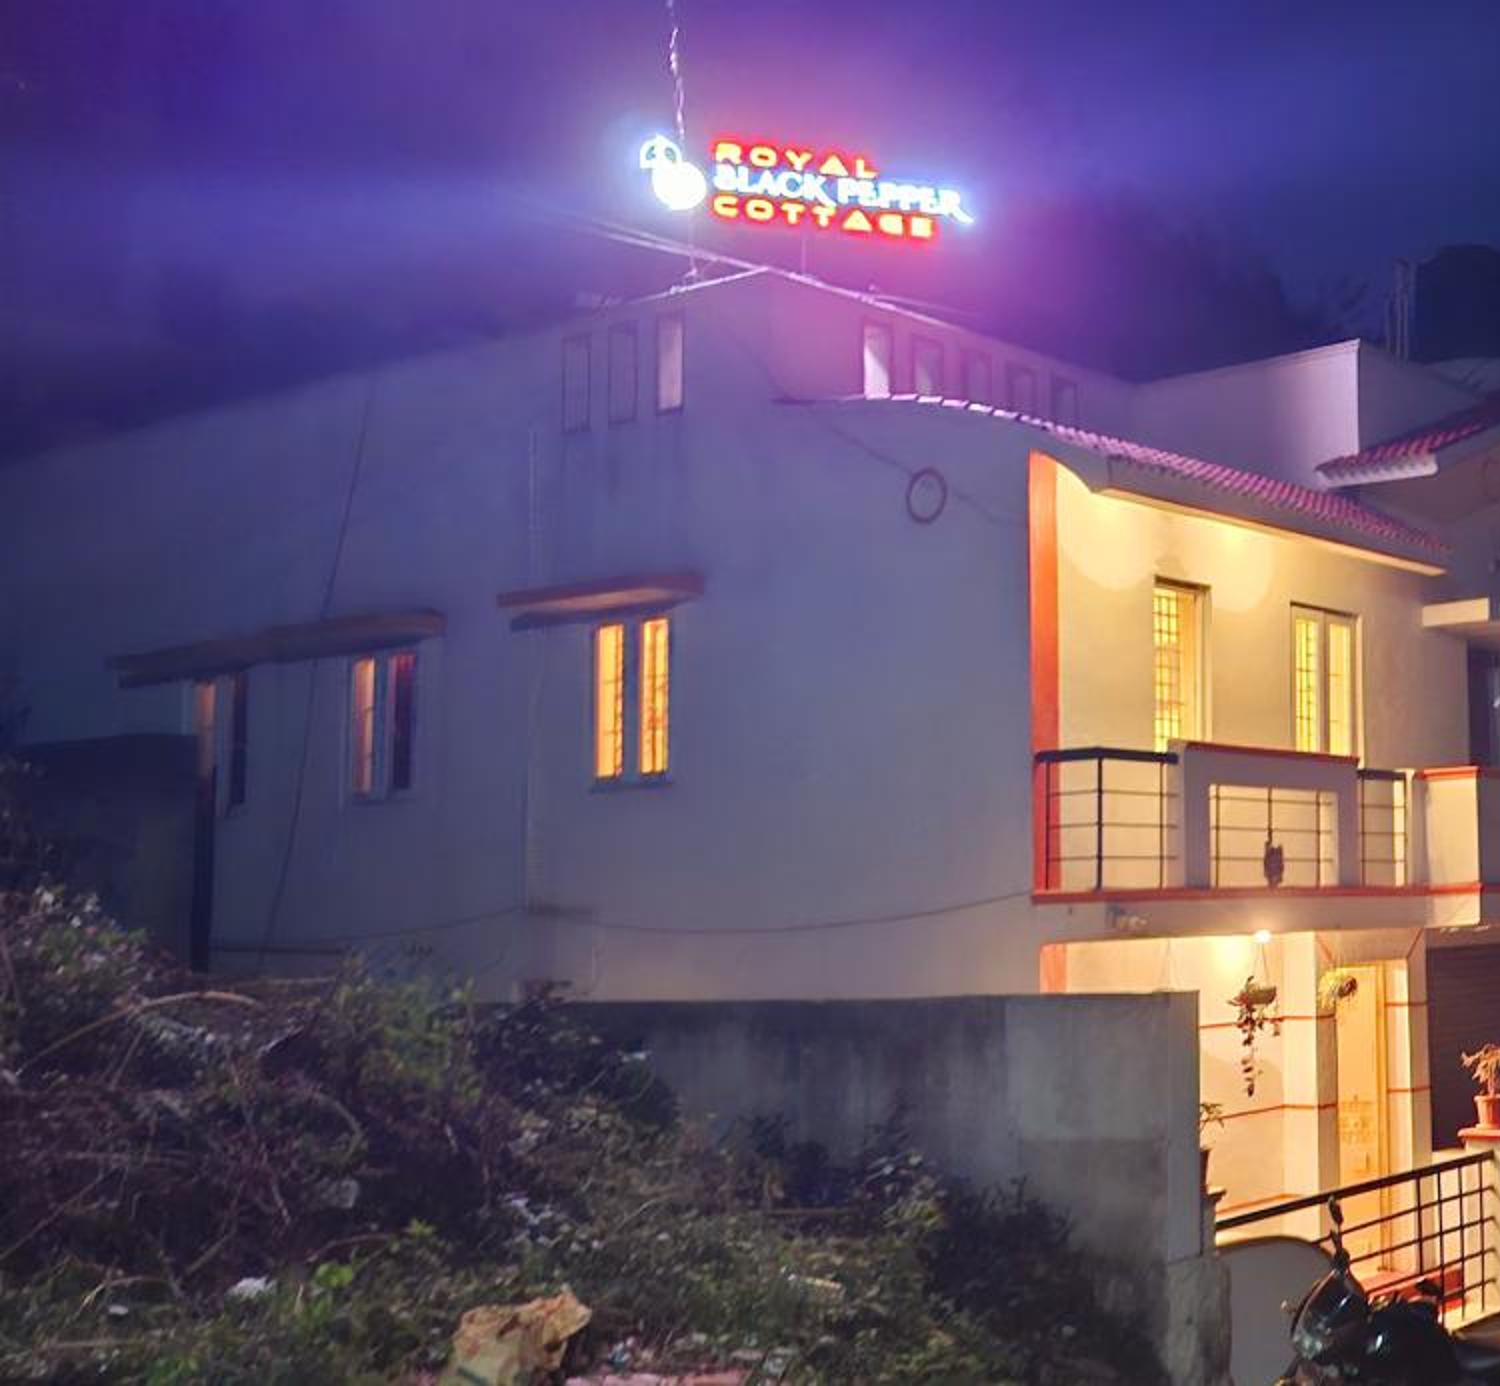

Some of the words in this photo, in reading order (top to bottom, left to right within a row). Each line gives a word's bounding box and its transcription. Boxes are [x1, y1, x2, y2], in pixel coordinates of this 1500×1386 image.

[714, 142, 878, 179] ROYAL
[712, 164, 838, 208] BLACK
[837, 179, 976, 225] PEPPER
[712, 194, 935, 239] COTTAGE
